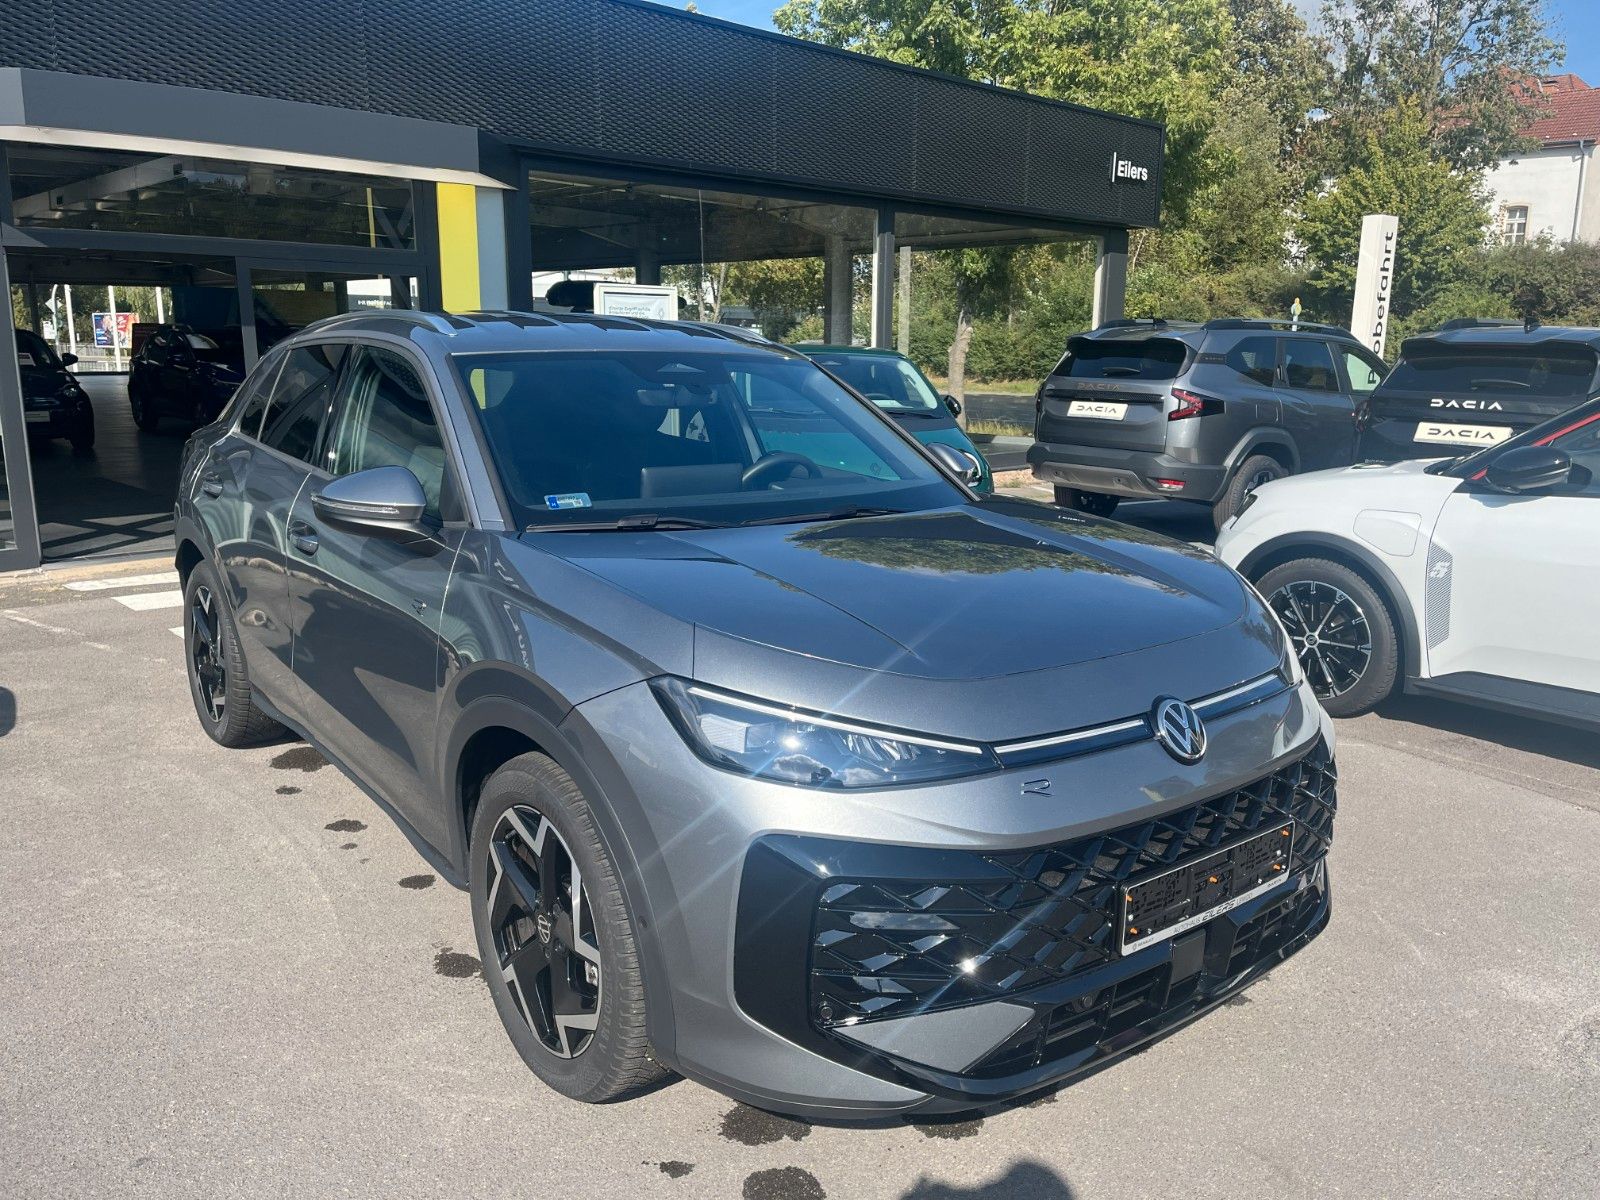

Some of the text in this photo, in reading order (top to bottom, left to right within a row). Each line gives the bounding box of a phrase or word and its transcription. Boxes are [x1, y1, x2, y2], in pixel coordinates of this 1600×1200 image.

[1117, 160, 1148, 181] Eilers
[1367, 231, 1394, 384] Pobefahrt
[1077, 382, 1120, 391] DACIA
[1076, 405, 1117, 414] DACIA
[1429, 399, 1503, 411] DACIA
[1427, 428, 1495, 440] DACIA
